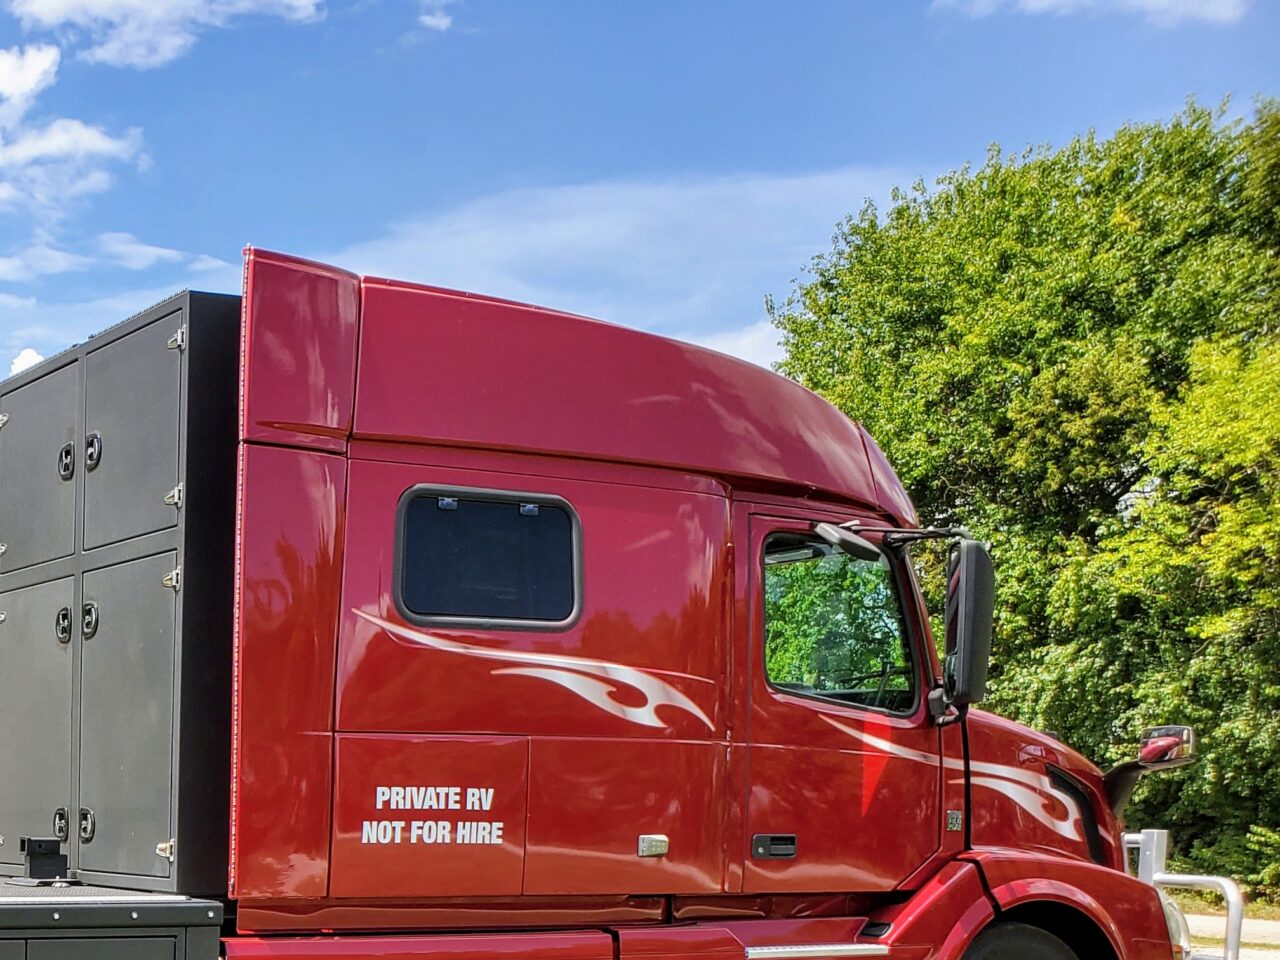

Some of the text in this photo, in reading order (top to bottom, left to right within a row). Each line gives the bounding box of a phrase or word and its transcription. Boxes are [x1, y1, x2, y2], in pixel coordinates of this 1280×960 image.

[376, 787, 494, 811] PRIVATE RV
[361, 821, 504, 844] NOT FOR HIRE
